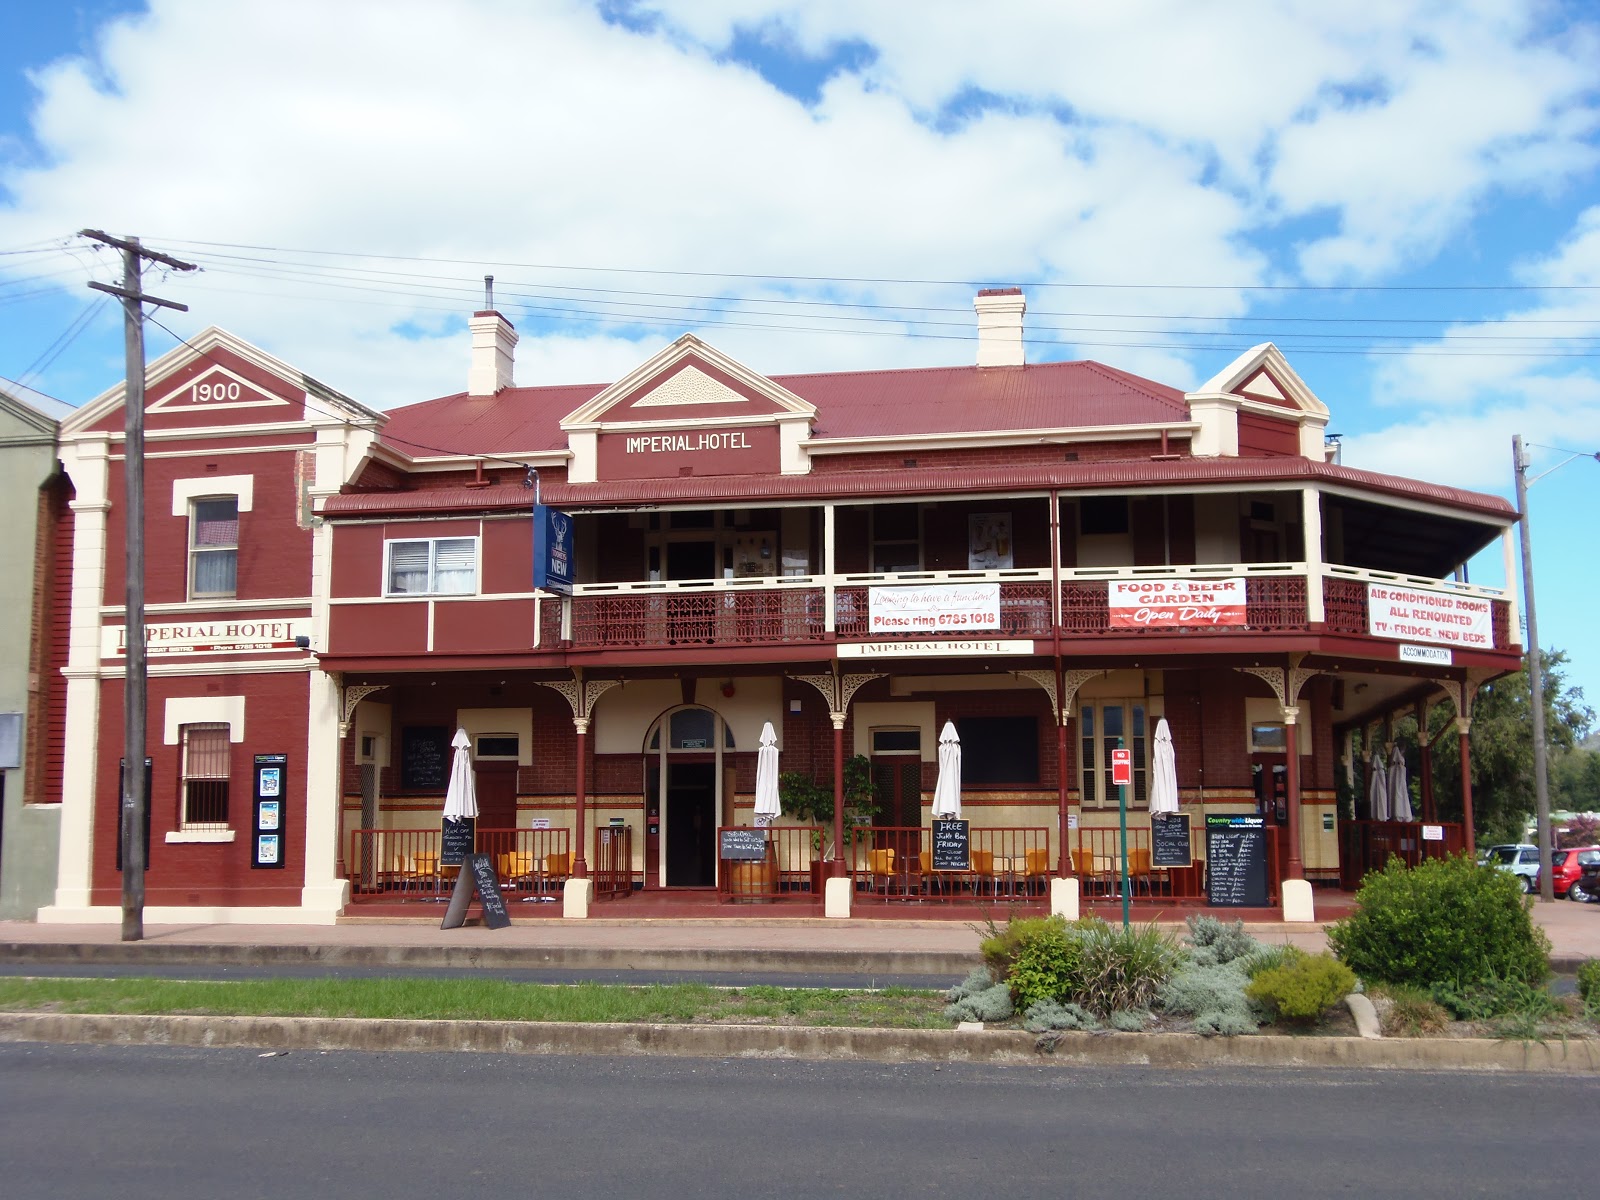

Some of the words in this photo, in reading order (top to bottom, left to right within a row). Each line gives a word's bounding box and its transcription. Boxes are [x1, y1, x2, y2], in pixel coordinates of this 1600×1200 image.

[192, 382, 240, 403] 1900
[551, 558, 567, 577] NEW
[1117, 583, 1166, 593] FOOD
[1171, 583, 1182, 591] &
[1188, 582, 1236, 592] BEER
[873, 592, 909, 608] Looking
[910, 592, 920, 603] to
[920, 592, 942, 603] have
[951, 590, 996, 607] function?
[1138, 594, 1215, 604] GARDEN
[1371, 588, 1388, 600] AIR
[1389, 591, 1454, 609] CONDITIONED
[1455, 600, 1489, 613] ROOMS
[873, 616, 910, 627] Please
[912, 615, 936, 628] ring
[938, 613, 968, 625] 6785
[970, 612, 996, 624] 1018
[1133, 607, 1175, 624] Open
[1178, 606, 1222, 623] Daily
[1389, 606, 1410, 618] ALL
[1412, 609, 1473, 626] RENOVATED
[118, 625, 220, 647] IPERIAL
[225, 622, 297, 641] HOTEL
[1375, 621, 1388, 632] TV
[1394, 624, 1432, 637] FRIDGE
[1438, 629, 1460, 640] NEW
[1463, 632, 1486, 643] BEDS
[860, 643, 944, 655] IMPERIAL
[947, 642, 1010, 652] HOTEL
[1402, 646, 1449, 660] ACCOMMODATION
[940, 821, 963, 831] FREE
[936, 841, 963, 849] FRIDAY
